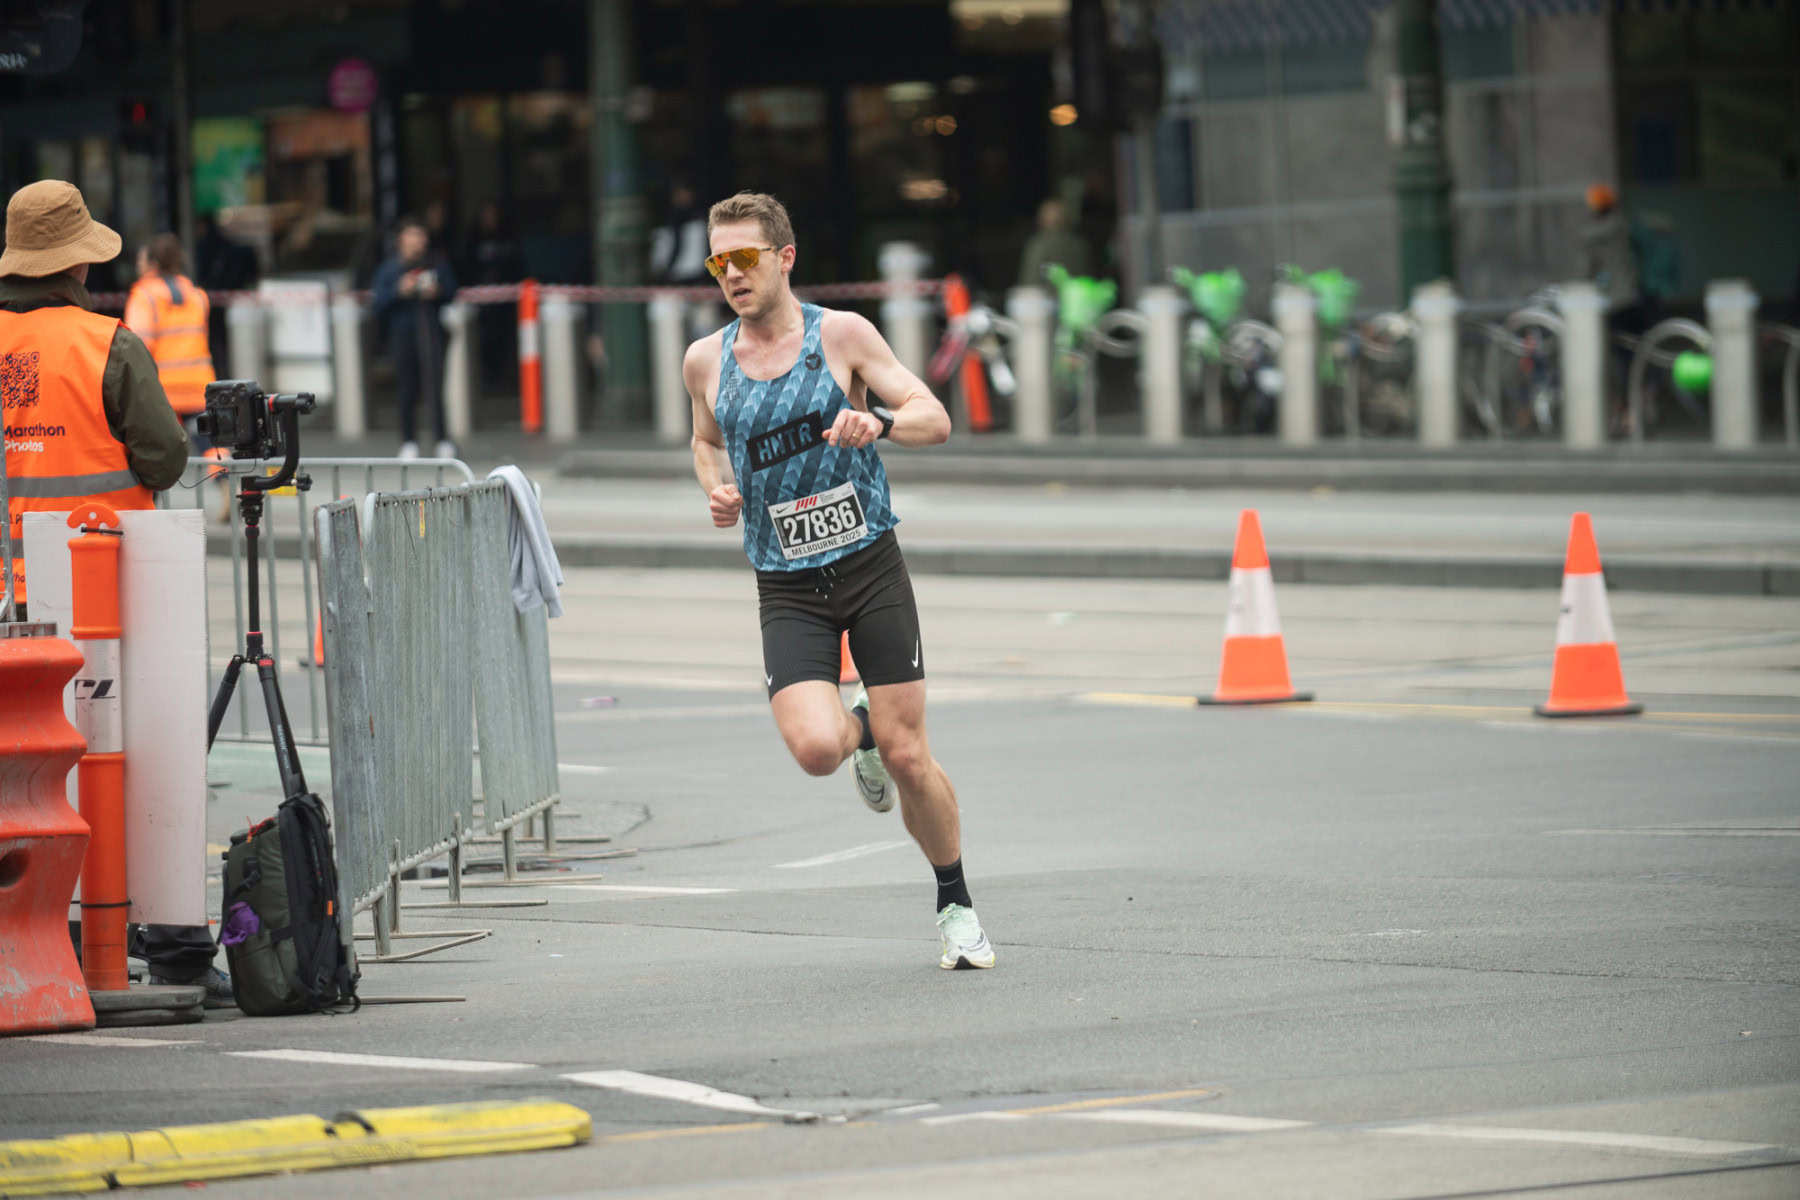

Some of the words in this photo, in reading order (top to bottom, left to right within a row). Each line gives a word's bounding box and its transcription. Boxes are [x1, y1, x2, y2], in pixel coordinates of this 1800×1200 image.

[5, 440, 44, 453] Photos
[757, 422, 813, 463] HNTR
[783, 501, 857, 546] 27836
[791, 537, 839, 556] MELBOURNE
[840, 529, 861, 544] 2025
